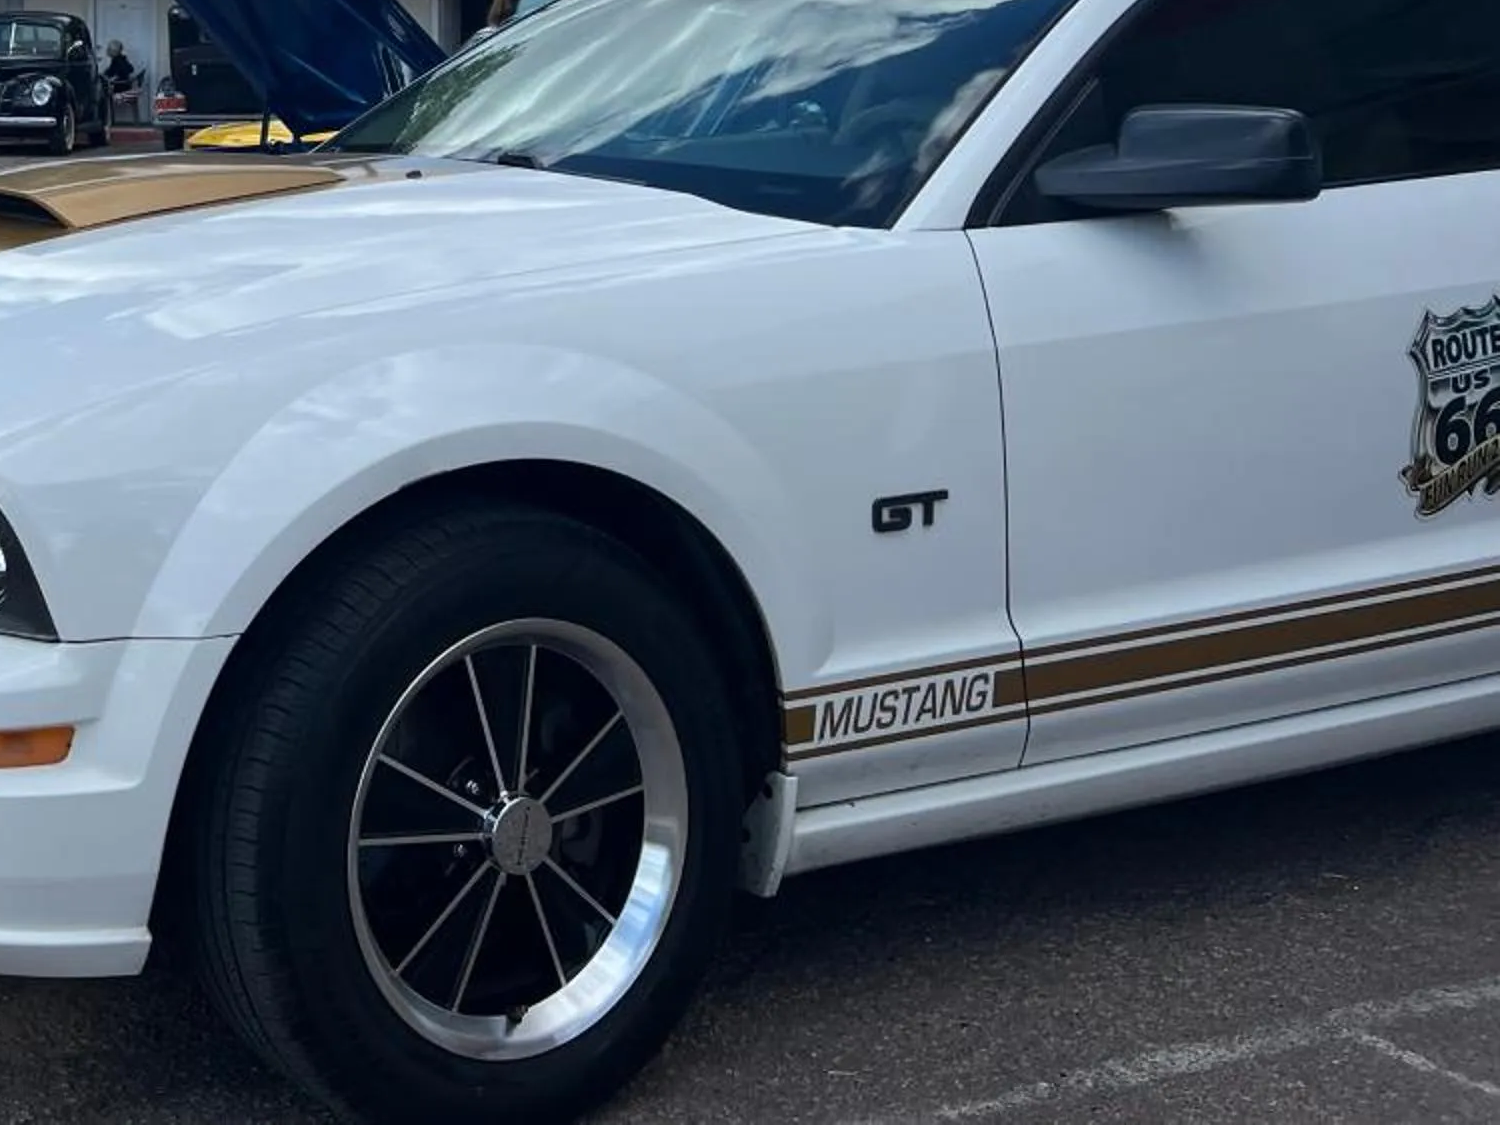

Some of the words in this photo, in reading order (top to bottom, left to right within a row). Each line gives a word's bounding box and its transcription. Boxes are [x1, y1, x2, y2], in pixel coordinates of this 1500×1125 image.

[1431, 324, 1500, 369] ROUTE
[1451, 369, 1490, 394] US
[871, 488, 949, 533] GT
[817, 672, 990, 744] MUSTANG
